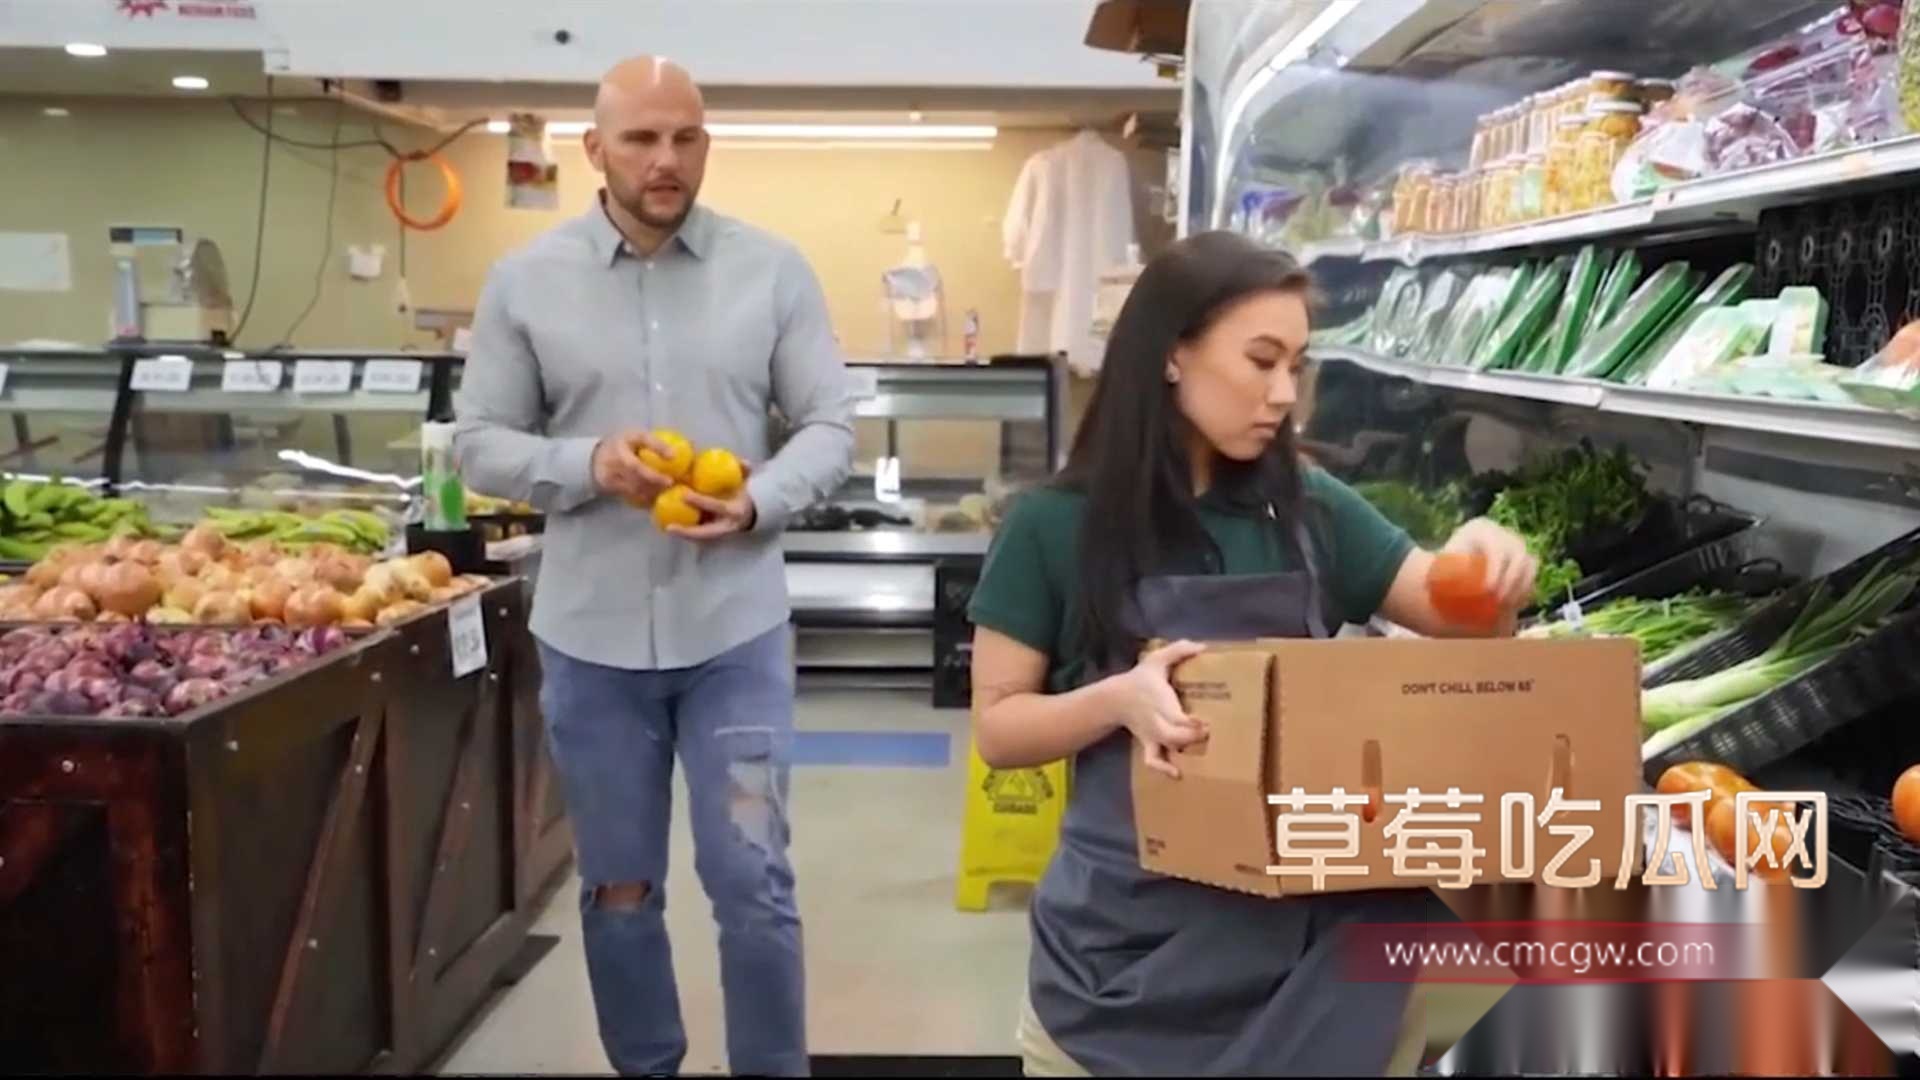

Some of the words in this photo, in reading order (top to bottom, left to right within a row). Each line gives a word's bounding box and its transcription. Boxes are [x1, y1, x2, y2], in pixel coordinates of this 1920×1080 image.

[1401, 682, 1436, 695] DON'T
[1439, 682, 1473, 694] CHILL
[1476, 681, 1515, 694] BELOW
